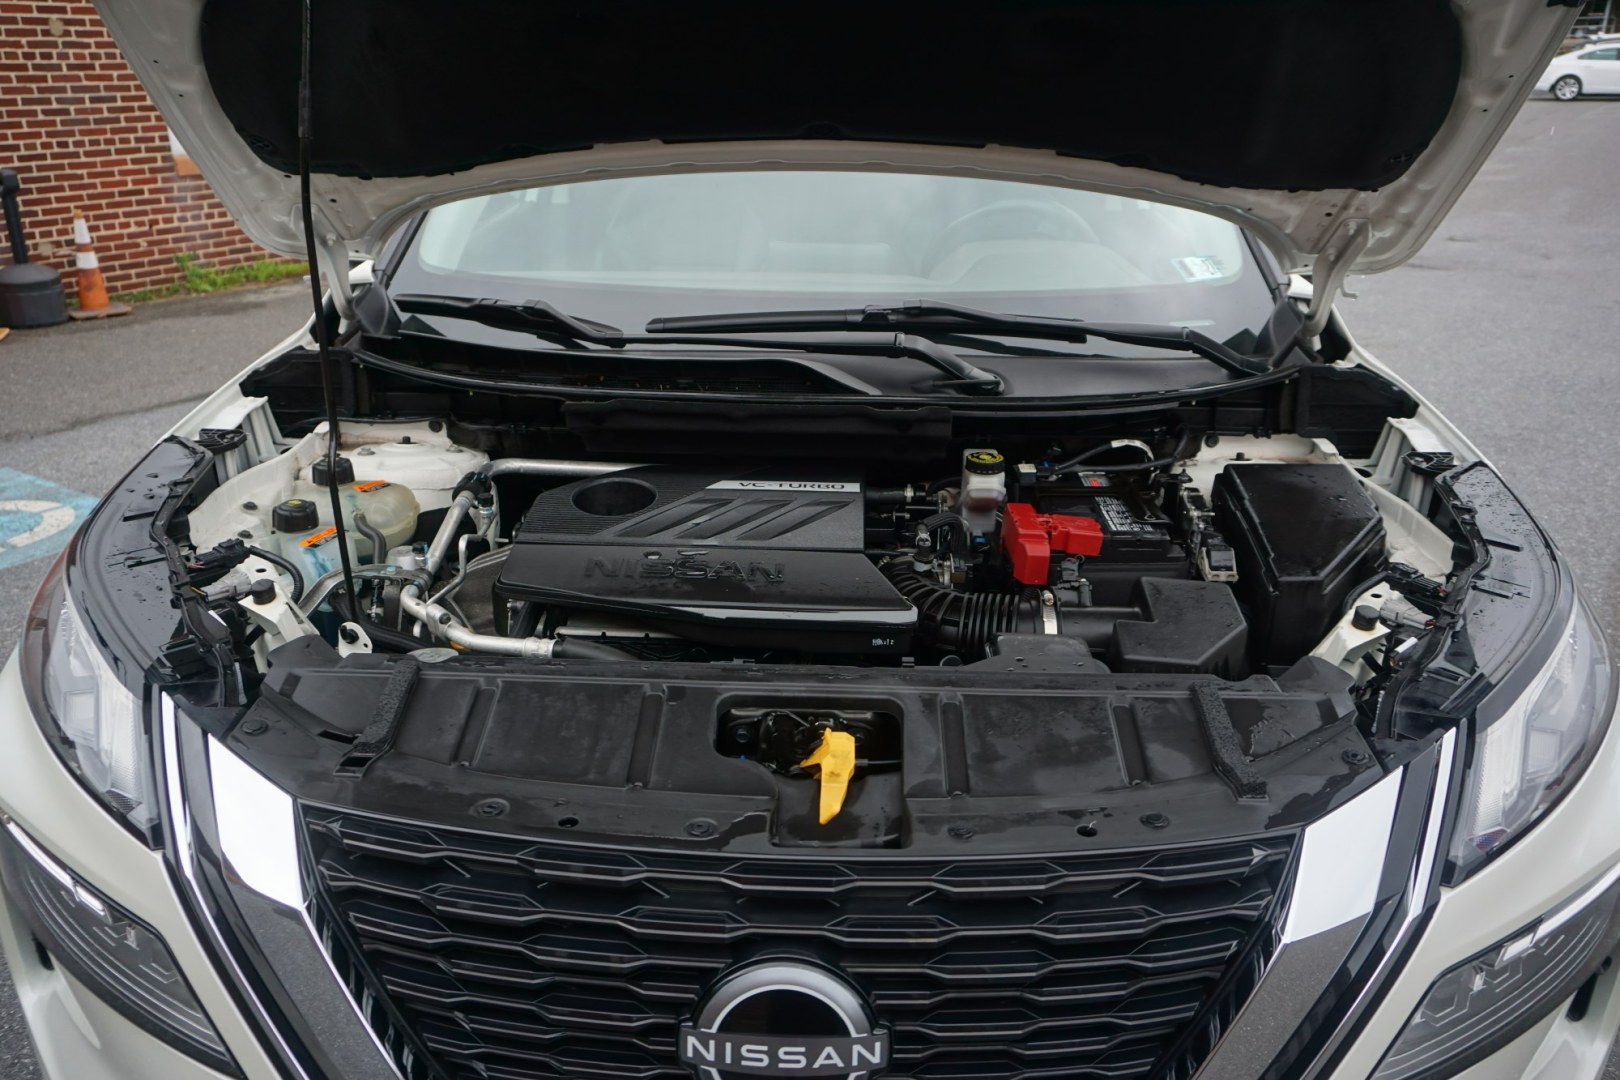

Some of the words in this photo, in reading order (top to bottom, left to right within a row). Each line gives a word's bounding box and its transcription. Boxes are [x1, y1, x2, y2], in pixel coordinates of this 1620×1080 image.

[739, 482, 845, 490] VC-TURBO
[584, 557, 785, 582] NISSAN
[686, 1035, 881, 1069] NISSAN
